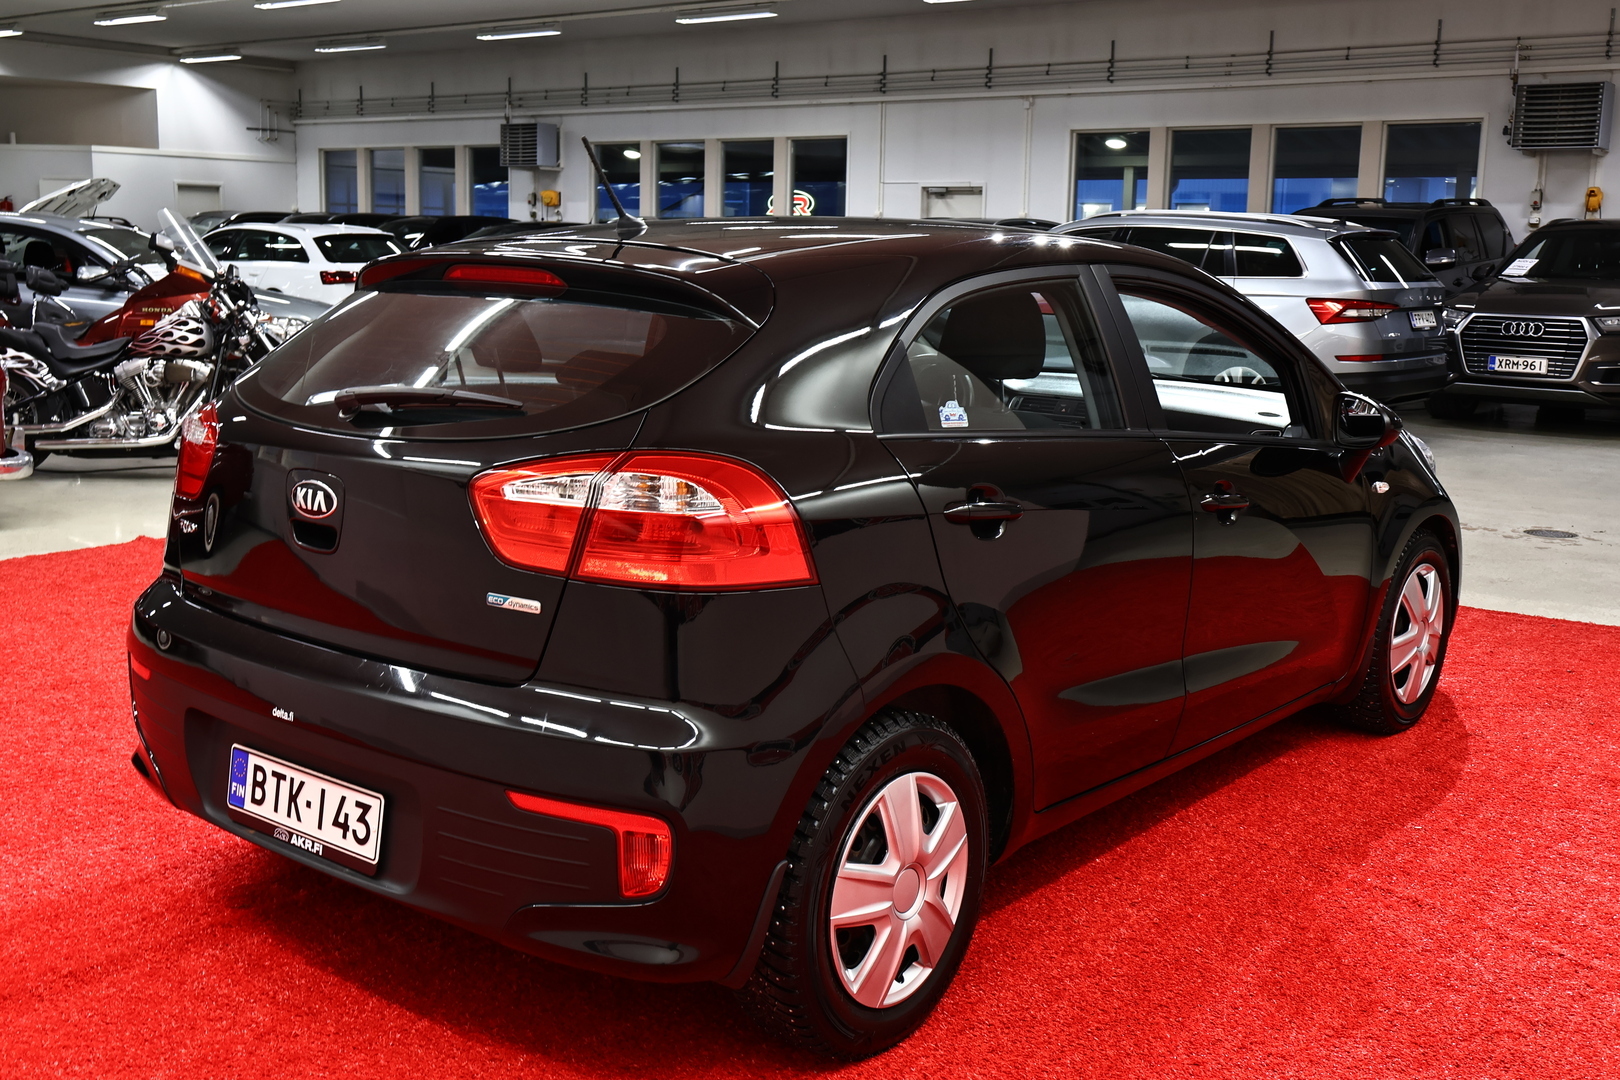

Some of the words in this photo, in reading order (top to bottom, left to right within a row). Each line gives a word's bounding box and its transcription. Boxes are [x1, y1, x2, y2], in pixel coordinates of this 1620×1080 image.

[1497, 358, 1543, 371] XRM-961
[296, 486, 328, 513] KIA
[488, 595, 505, 605] ECO
[508, 599, 539, 611] dynamics
[272, 706, 295, 722] delta.fi
[841, 741, 907, 812] NEXEN
[231, 781, 246, 799] FIN
[250, 763, 372, 846] BTK-143
[290, 833, 324, 857] AKR.FI
